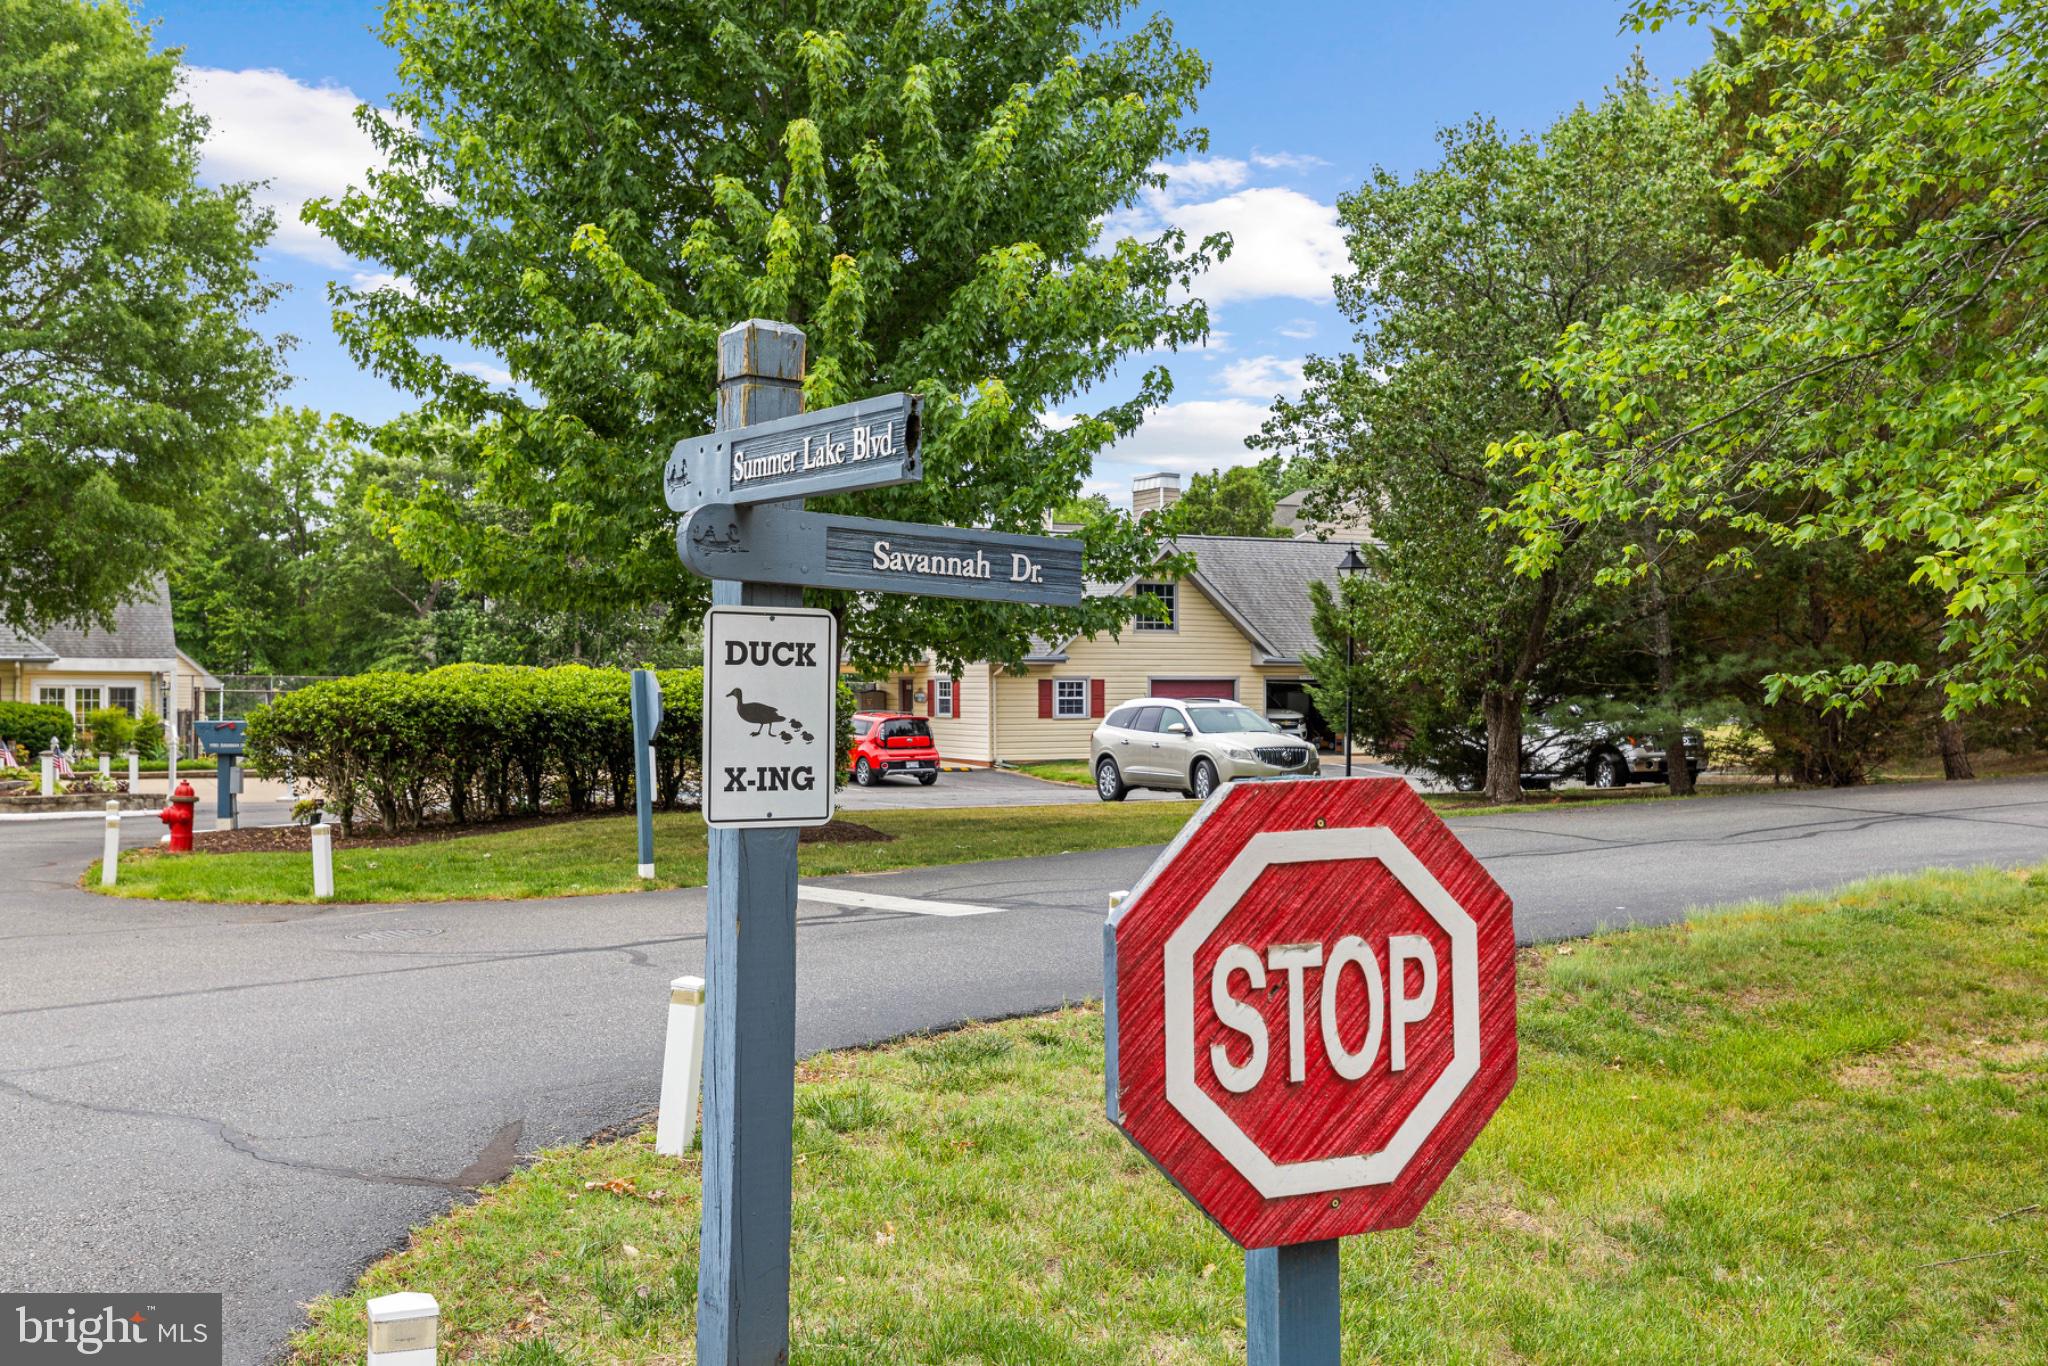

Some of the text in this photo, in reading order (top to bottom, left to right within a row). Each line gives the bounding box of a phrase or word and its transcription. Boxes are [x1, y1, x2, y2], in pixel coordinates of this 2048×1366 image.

[733, 421, 897, 482] Summer Lake Blvd.
[872, 541, 1043, 583] Savannah Dr.
[725, 640, 817, 667] DUCK
[724, 766, 815, 792] X-ING
[1210, 935, 1438, 1093] STOP
